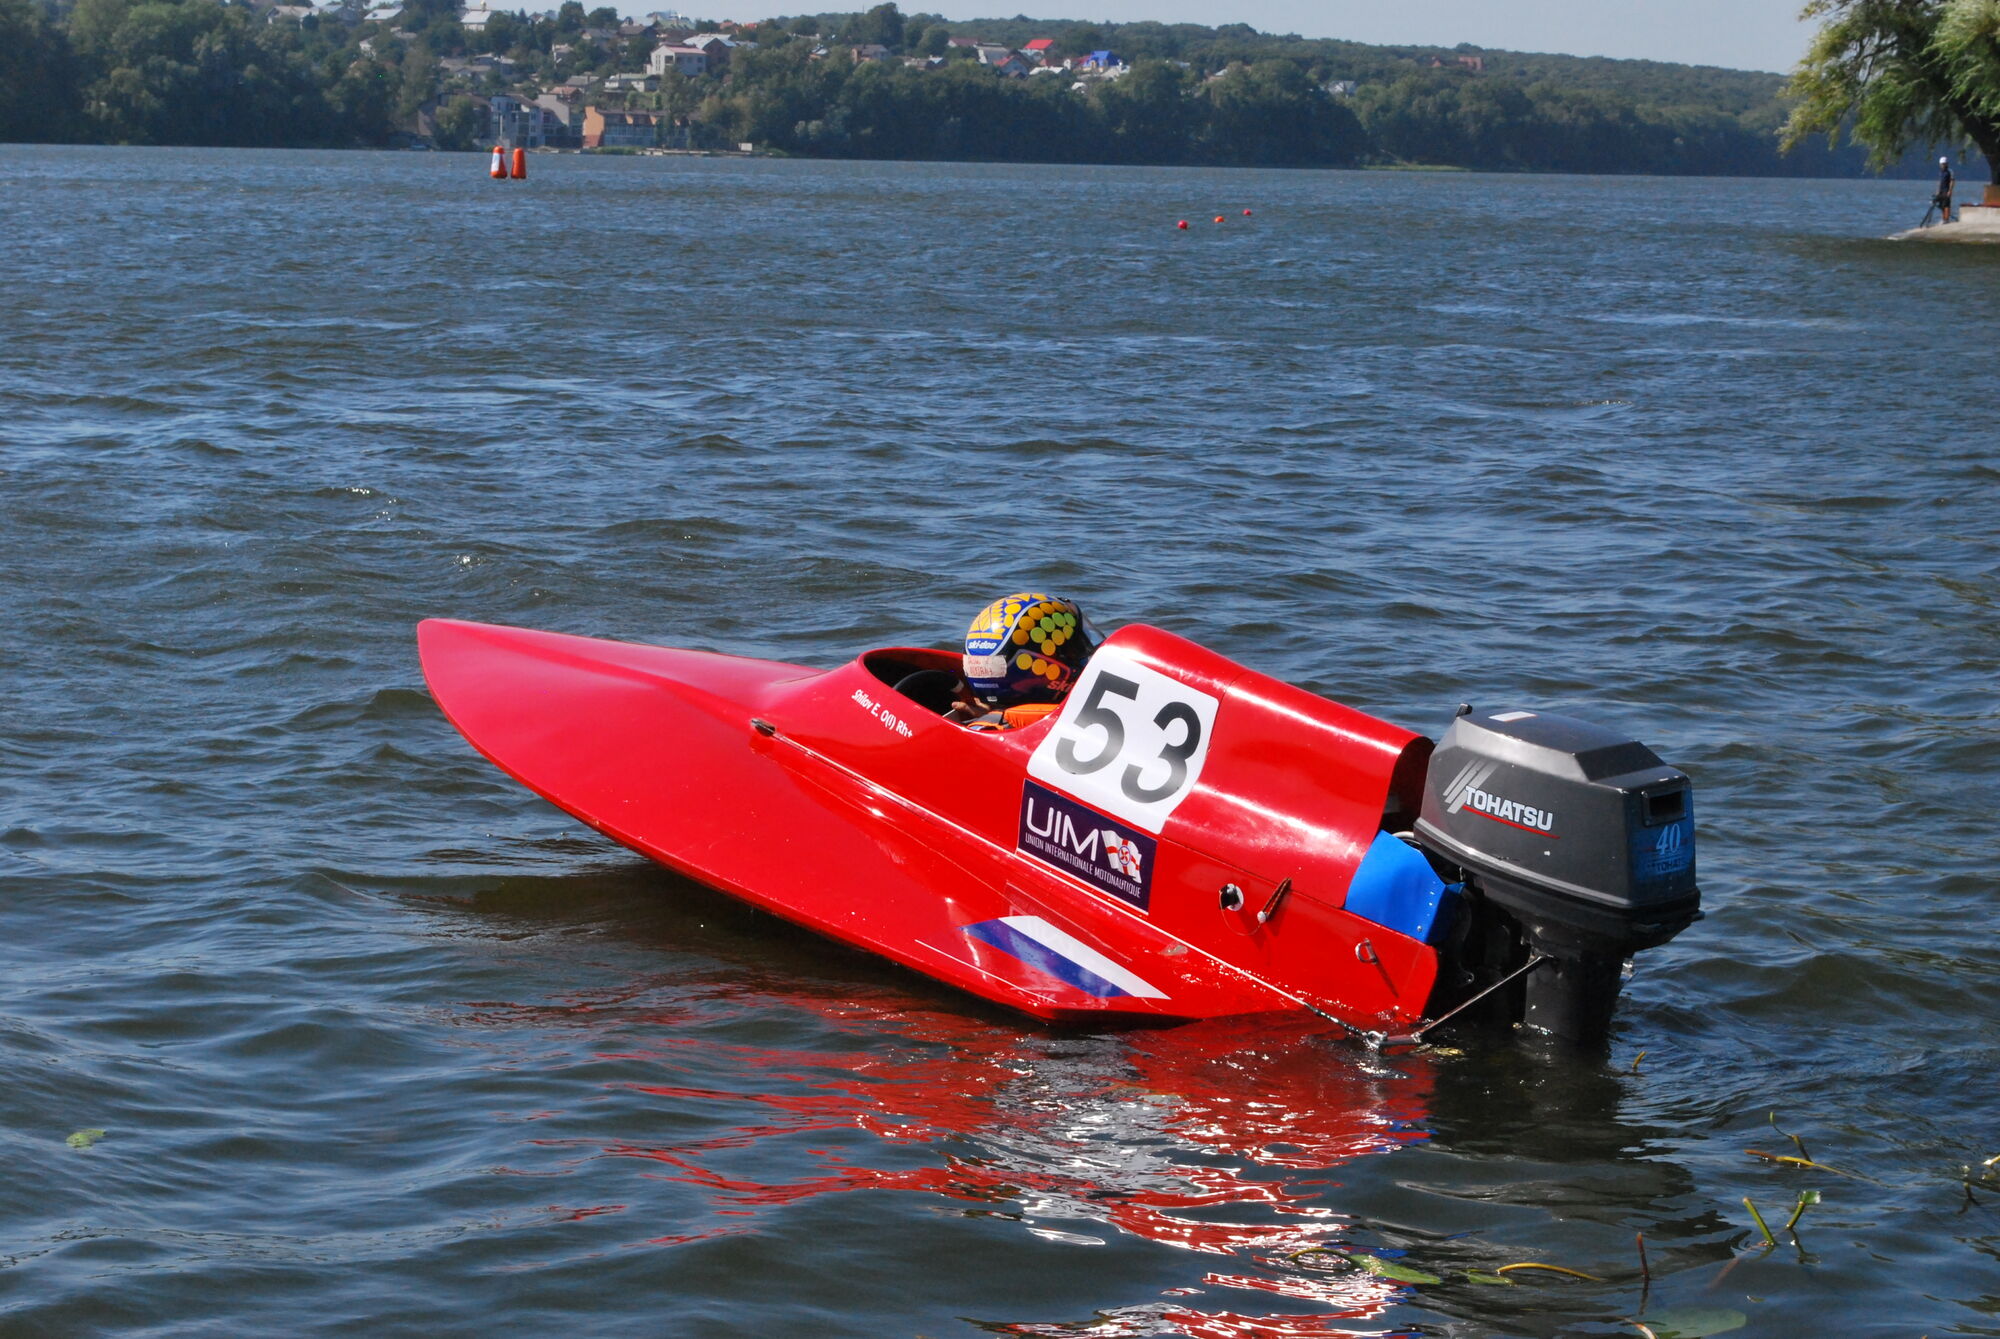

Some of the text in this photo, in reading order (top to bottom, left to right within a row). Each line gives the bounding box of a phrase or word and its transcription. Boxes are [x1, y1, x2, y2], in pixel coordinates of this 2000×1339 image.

[968, 640, 997, 649] ski-doo
[851, 689, 873, 709] Shilov
[871, 702, 880, 717] E.
[896, 720, 912, 737] Rh+
[1055, 670, 1201, 803] 53
[1026, 797, 1099, 862] UIM
[1465, 786, 1553, 831] TOHATSU
[1656, 824, 1680, 855] 40
[1025, 832, 1141, 898] UNION INTERNATIONALE MOTONAUTIQUE
